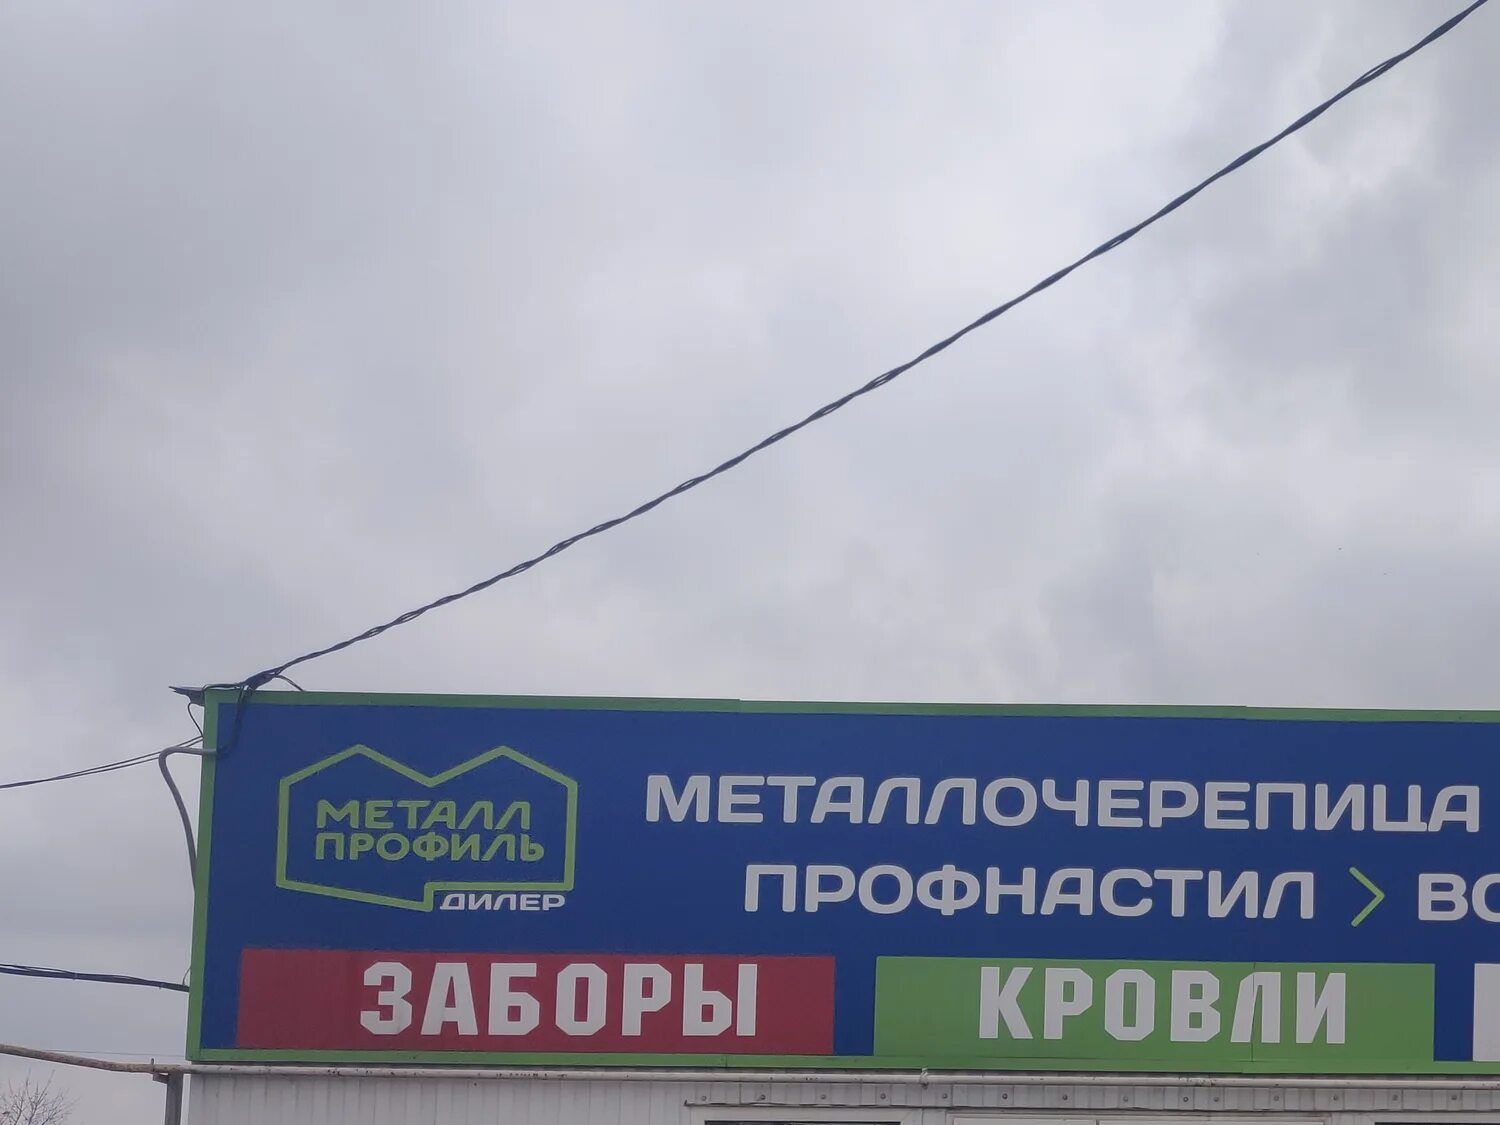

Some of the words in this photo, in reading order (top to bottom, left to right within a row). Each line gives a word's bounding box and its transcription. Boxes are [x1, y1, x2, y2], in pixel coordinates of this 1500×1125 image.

[315, 799, 530, 830] МЕТАЛЛ
[646, 775, 1480, 832] МЕТАЛЛОЧЕРЕПИЦА
[314, 832, 544, 862] ПРОФИЛЬ
[439, 892, 566, 912] ДИЛЕР
[744, 864, 1314, 919] ПРОФНАСТИЛ
[360, 960, 758, 1038] ЗАБОРЫ
[978, 966, 1346, 1044] КРОВЛИ
